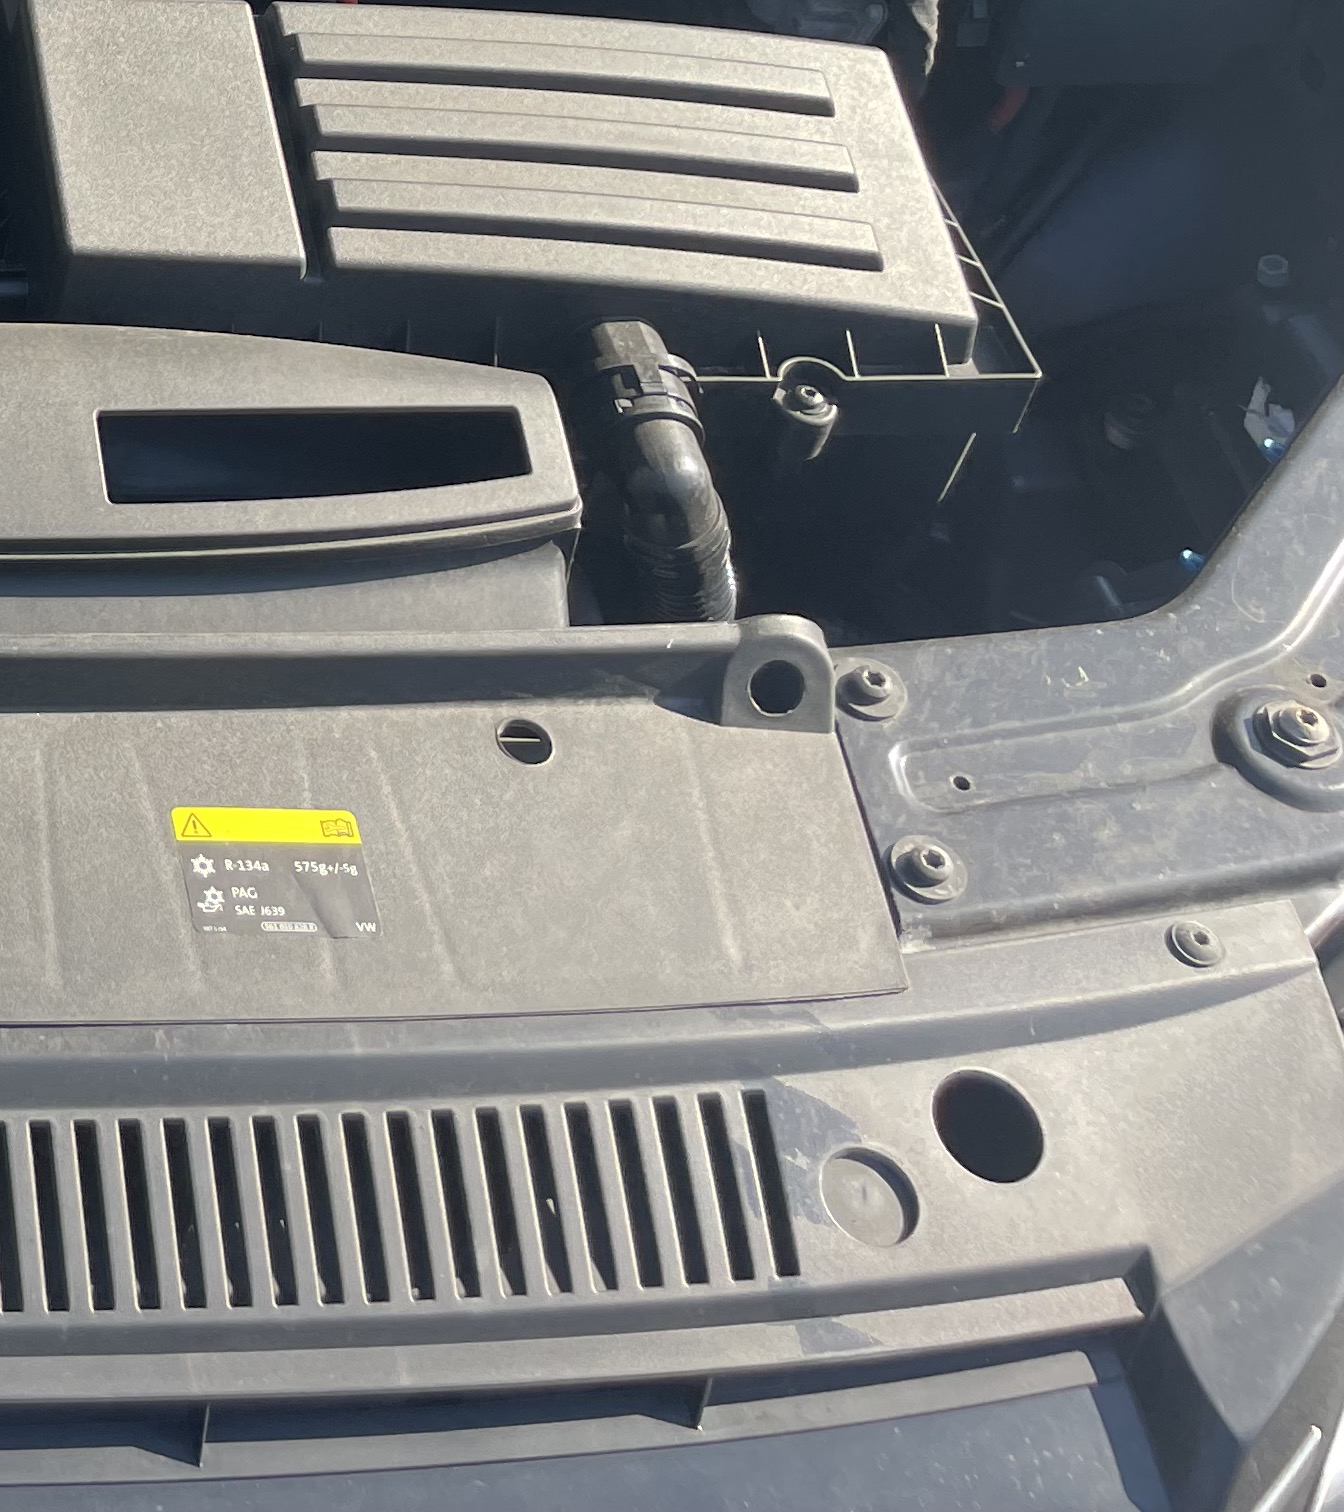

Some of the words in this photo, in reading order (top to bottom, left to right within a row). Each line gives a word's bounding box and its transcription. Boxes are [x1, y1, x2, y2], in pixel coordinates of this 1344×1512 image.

[224, 859, 270, 872] R-134a
[294, 860, 359, 877] 575g+/-5g
[231, 886, 258, 899] PAG
[234, 905, 256, 916] SAE
[356, 922, 377, 933] VW
